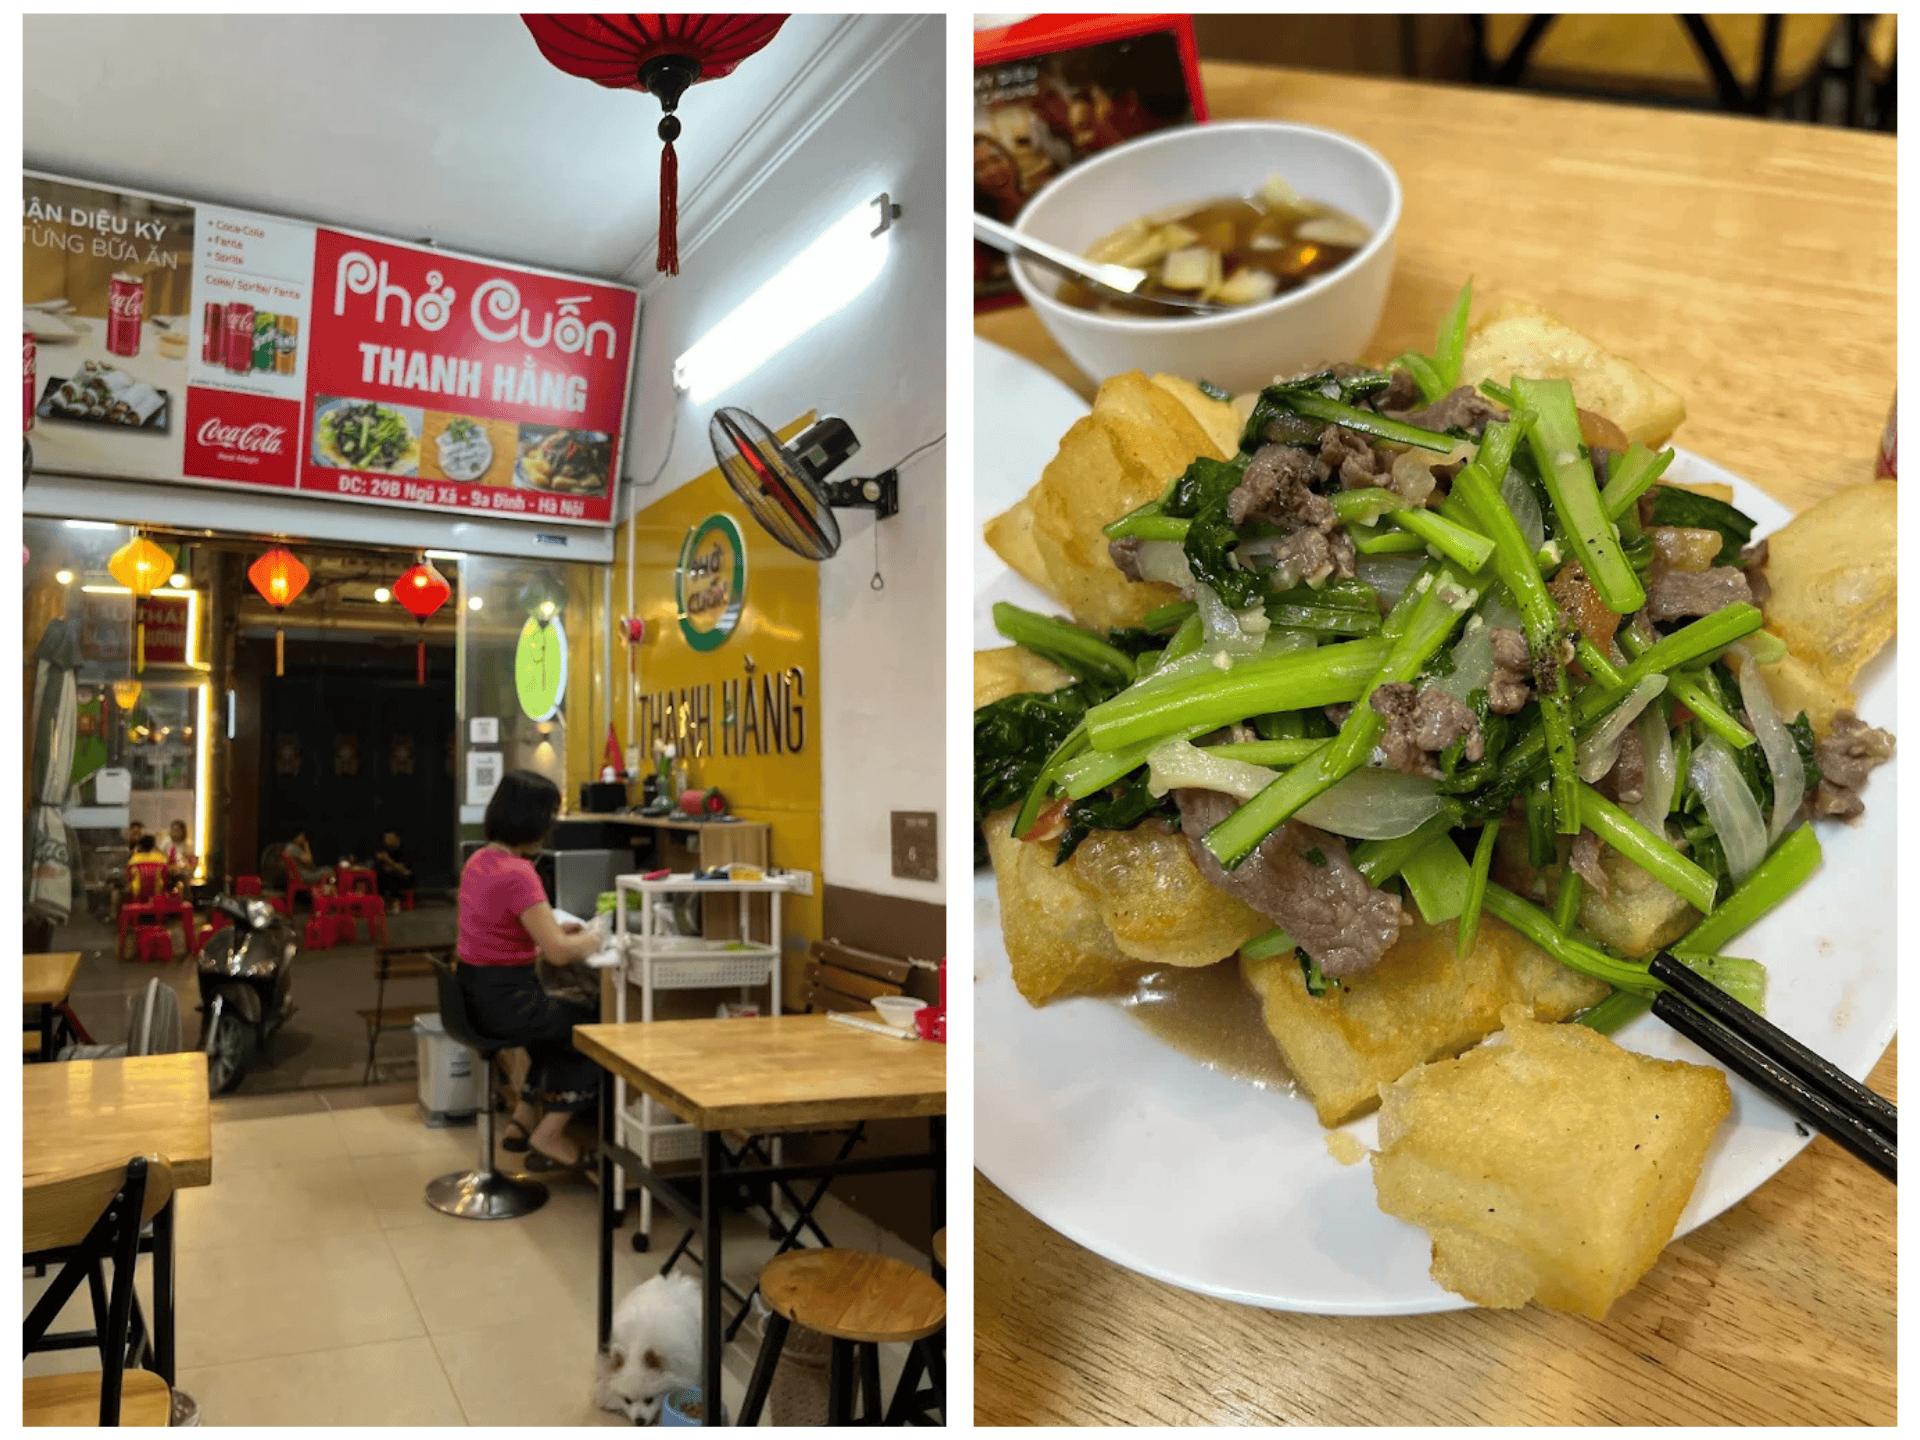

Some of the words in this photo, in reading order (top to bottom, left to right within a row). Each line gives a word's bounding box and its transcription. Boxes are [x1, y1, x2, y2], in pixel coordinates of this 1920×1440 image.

[23, 196, 62, 224] ẬN
[71, 208, 128, 236] DIỆU
[216, 220, 265, 238] Coca-Cola
[92, 237, 139, 263] BỮA
[145, 244, 178, 270] ĂN
[334, 251, 456, 331] Phở
[470, 278, 617, 360] Cuốn
[359, 341, 482, 399] THANH
[491, 354, 588, 414] HẰNG
[197, 417, 287, 455] Coca-Cola
[370, 478, 401, 498] 29B
[639, 684, 714, 760] THANH
